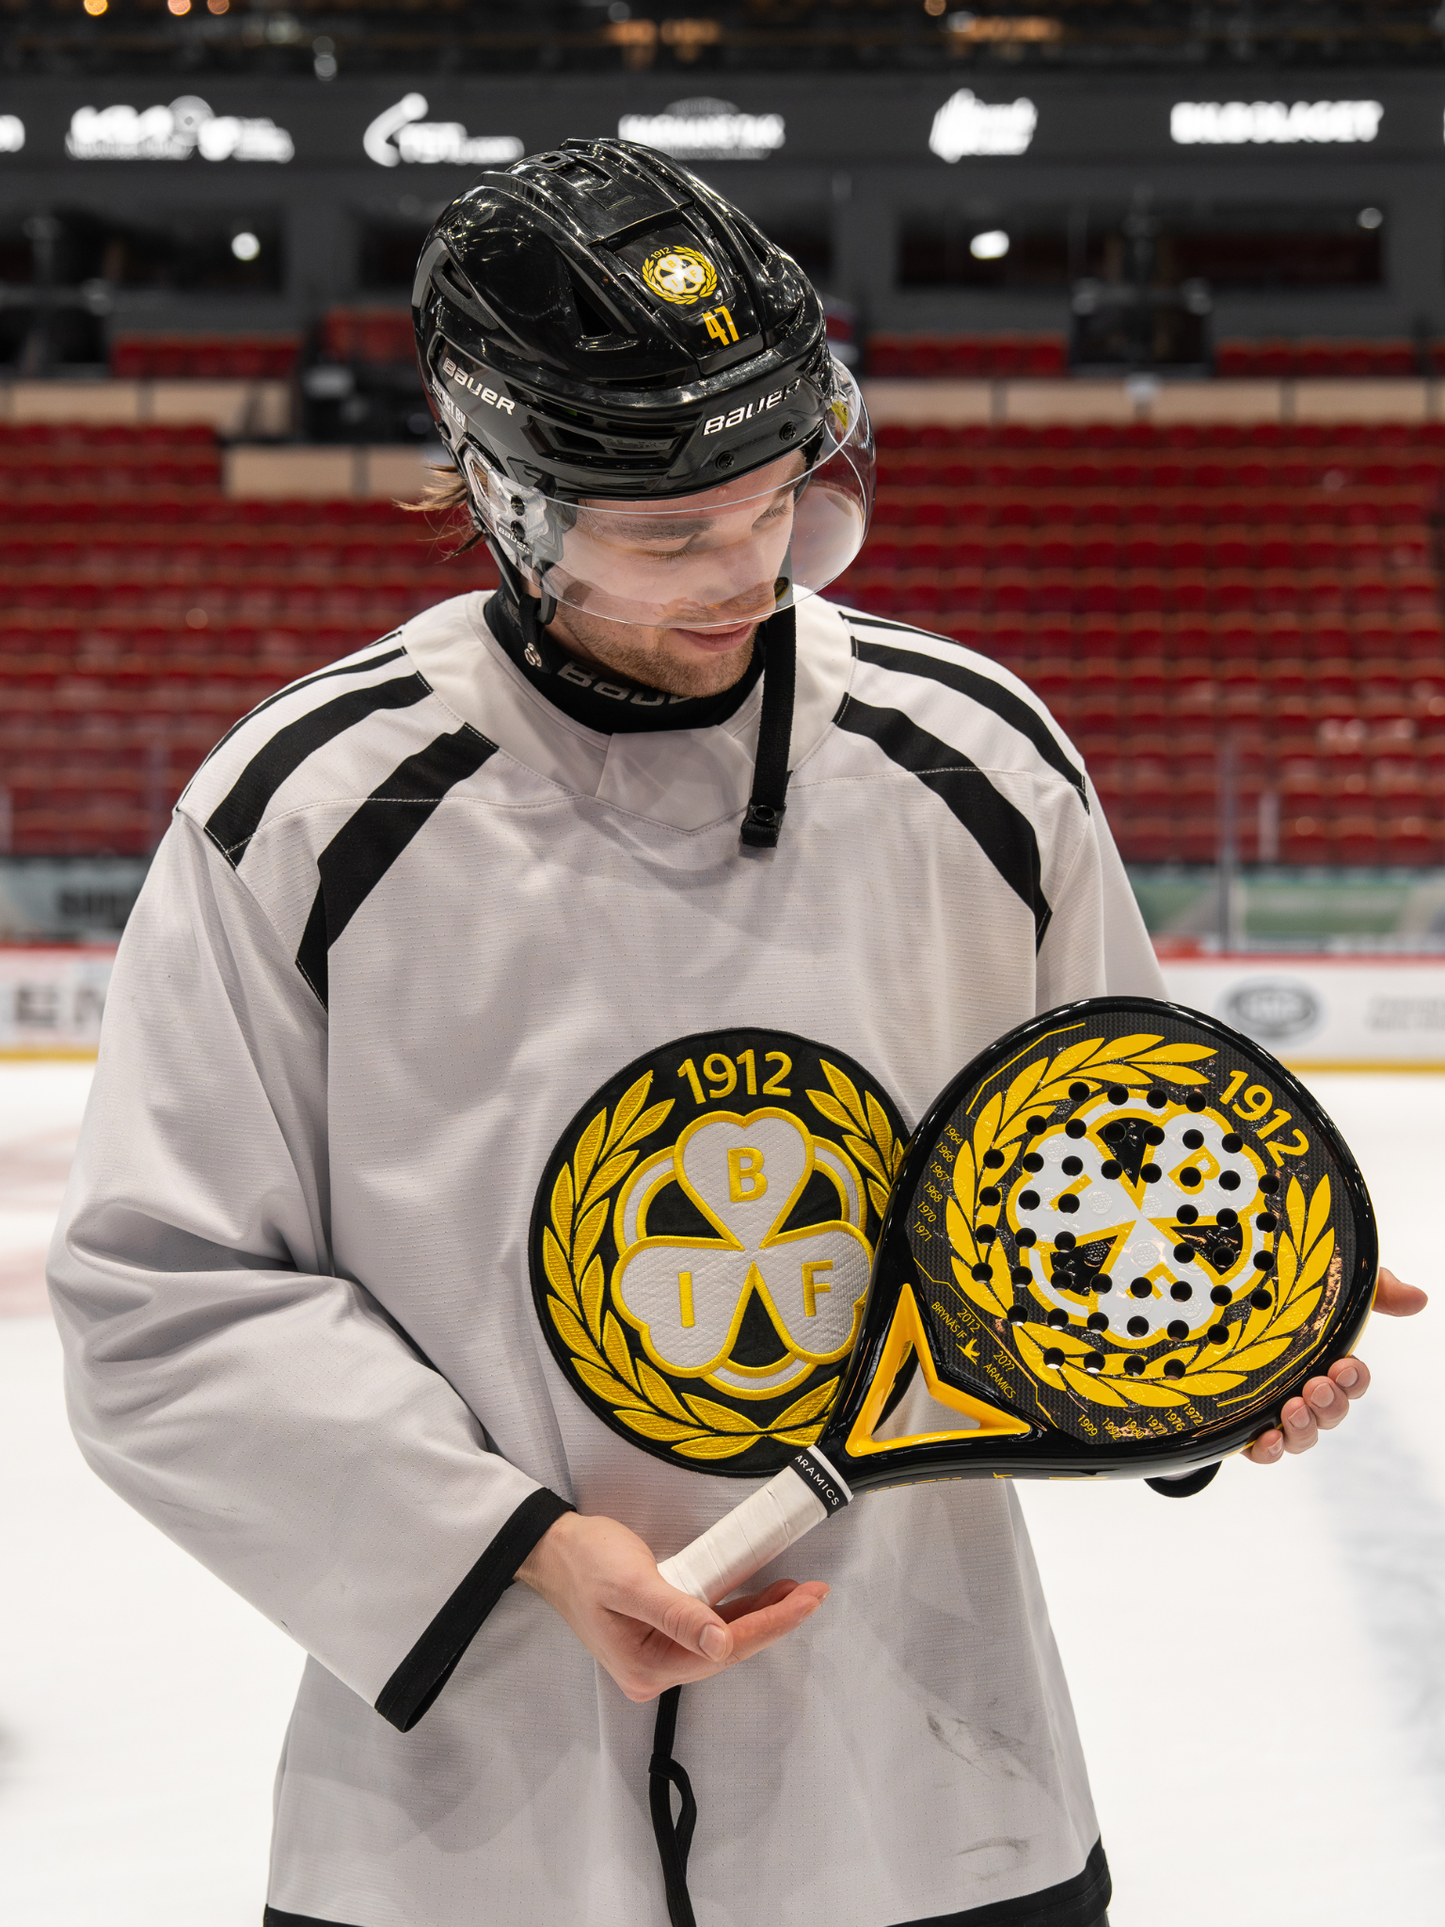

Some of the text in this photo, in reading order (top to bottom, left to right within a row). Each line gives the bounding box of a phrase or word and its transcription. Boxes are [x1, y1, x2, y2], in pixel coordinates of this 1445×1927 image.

[650, 246, 672, 260] 1912
[666, 259, 677, 268] B
[689, 269, 698, 279] F
[702, 305, 740, 346] 47
[442, 357, 516, 415] BAUER
[702, 378, 801, 436] BAUER
[677, 1049, 792, 1104] 1912
[1218, 1069, 1310, 1168] 1912
[943, 1123, 963, 1145] 1964
[935, 1141, 955, 1163] 1966
[727, 1147, 768, 1203] B
[929, 1161, 950, 1181] 1967
[923, 1181, 943, 1203] 1968
[916, 1201, 937, 1223] 1970
[912, 1220, 932, 1242] 1971
[678, 1260, 833, 1328] I F
[931, 1301, 967, 1339] BRYNÄS IF
[957, 1308, 981, 1333] 2012
[992, 1350, 1015, 1372] 20??
[983, 1363, 1017, 1399] ARAMICS
[1077, 1414, 1098, 1437] 1999
[1146, 1414, 1168, 1436] 1977
[1164, 1408, 1186, 1432] 1976
[1182, 1403, 1204, 1427] 1972
[1101, 1417, 1122, 1441] 1992
[795, 1455, 840, 1506] ARAMICS
